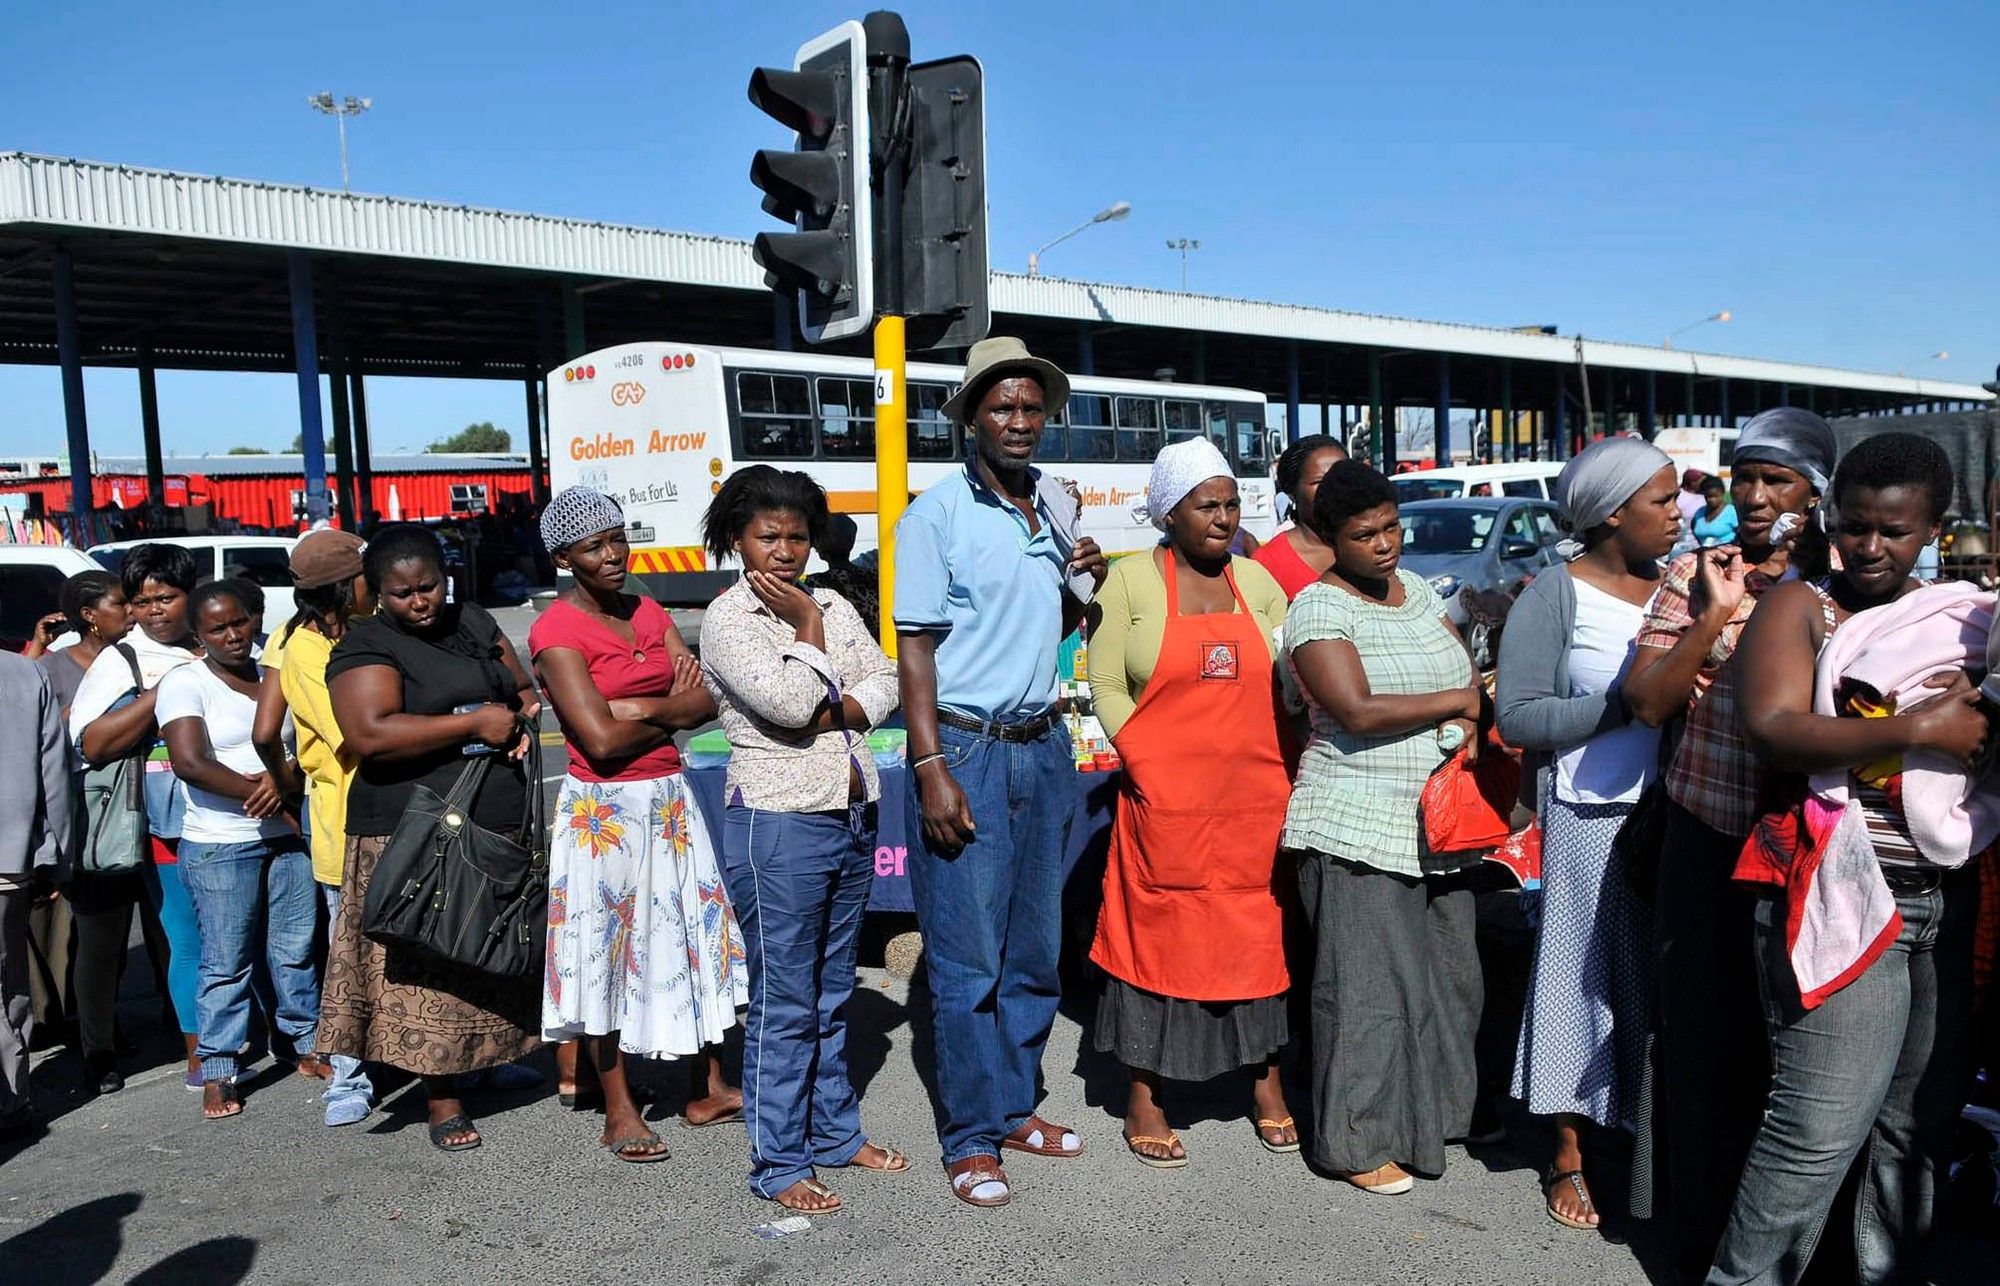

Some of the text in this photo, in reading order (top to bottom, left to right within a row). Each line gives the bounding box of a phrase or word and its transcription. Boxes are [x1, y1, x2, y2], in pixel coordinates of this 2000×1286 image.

[877, 376, 884, 399] 6
[570, 429, 706, 461] Golden Arrow
[629, 487, 647, 503] Bus
[648, 484, 664, 501] For
[665, 480, 678, 497] Us
[1080, 486, 1106, 506] lden
